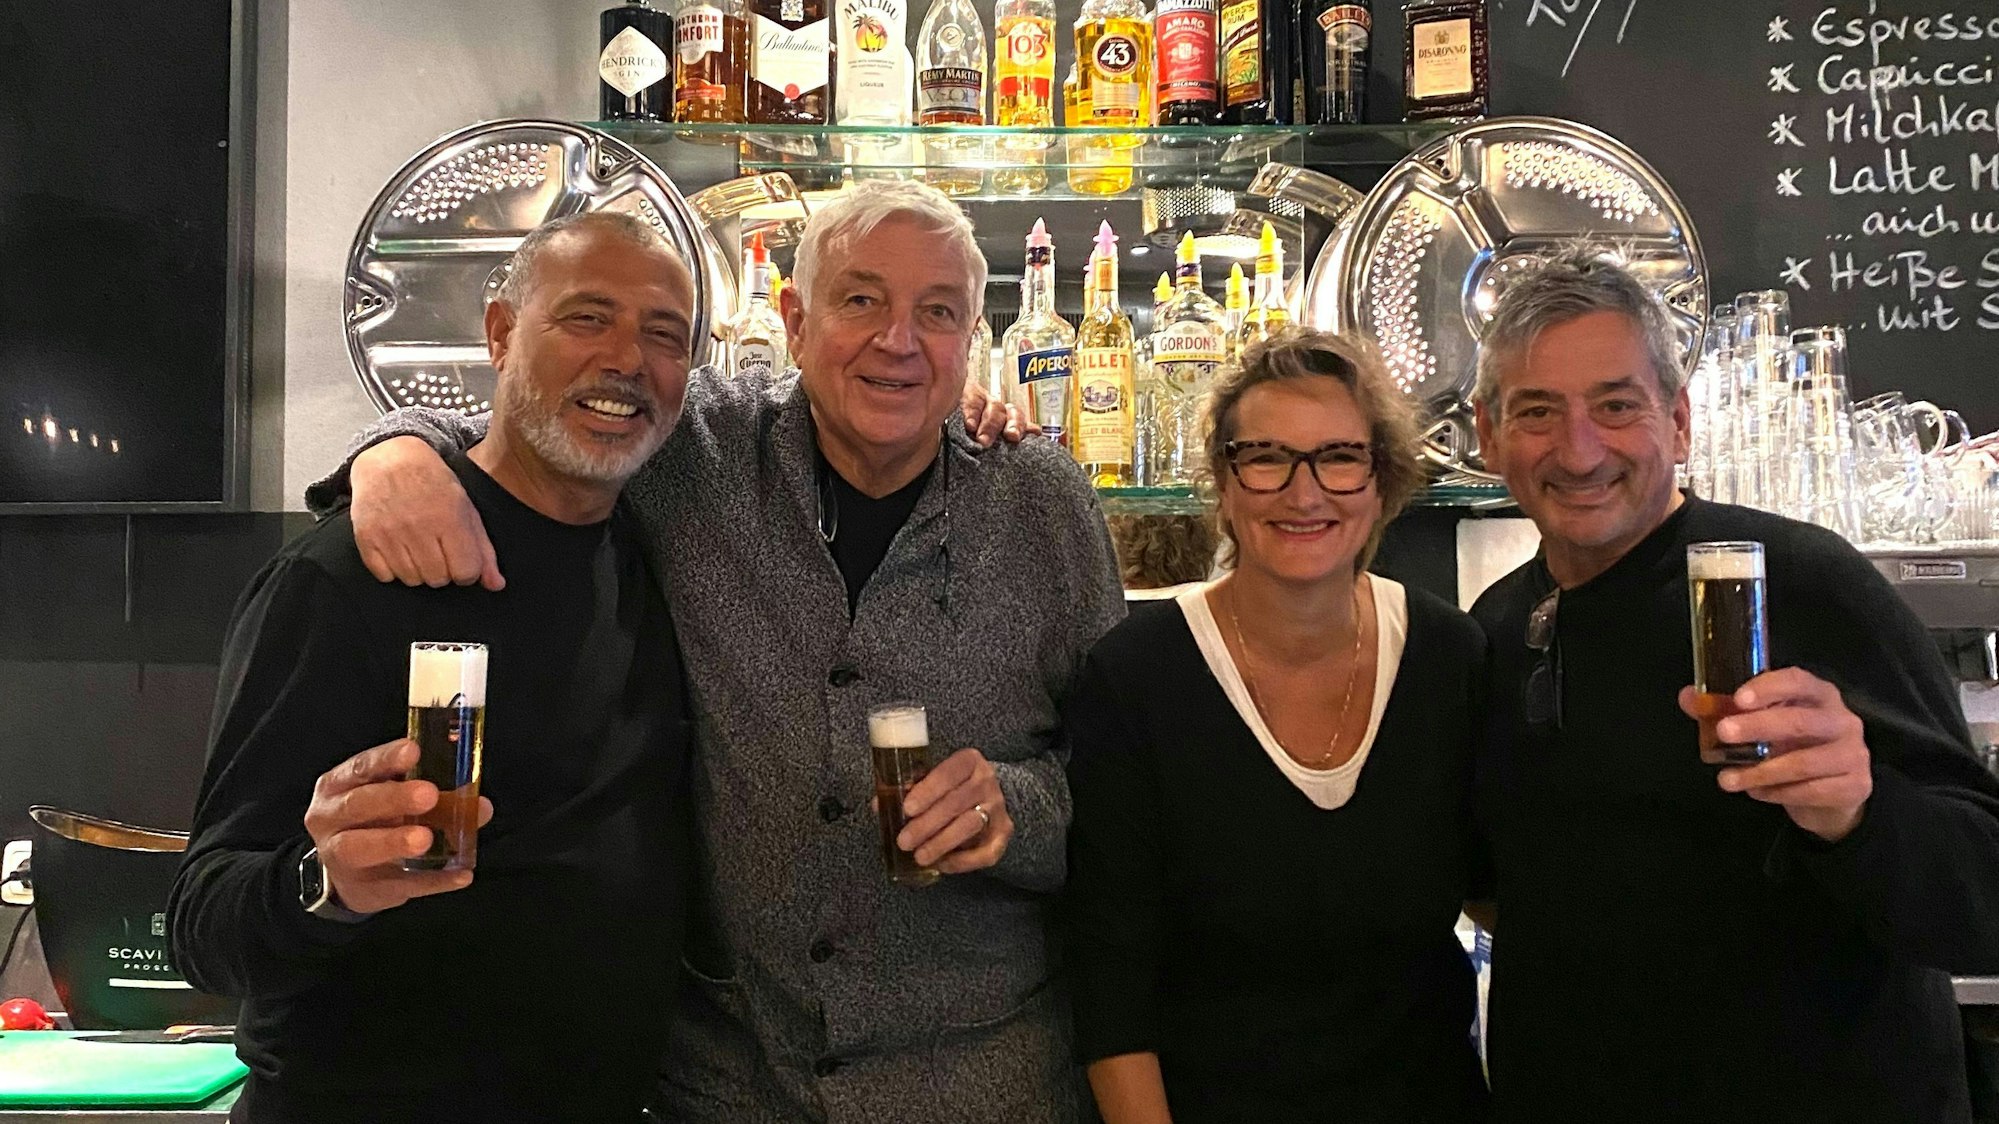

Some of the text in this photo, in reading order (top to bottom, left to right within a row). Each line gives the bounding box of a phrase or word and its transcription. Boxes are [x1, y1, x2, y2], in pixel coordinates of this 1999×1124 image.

[844, 0, 899, 20] MALIBU
[1321, 8, 1372, 26] BAILEYS
[677, 14, 718, 28] OUTHERN
[1166, 16, 1205, 31] AMARO
[677, 26, 719, 44] OMFORT
[1007, 34, 1046, 60] 103
[1100, 43, 1130, 66] 43
[1418, 44, 1467, 59] DISARONNO
[946, 68, 980, 81] MARTIN
[1826, 94, 1999, 144] Milchka
[1829, 148, 1956, 195] Latte
[1829, 250, 1968, 301] Heiße
[1160, 335, 1217, 352] GORDON'S
[108, 947, 162, 960] SCAVI
